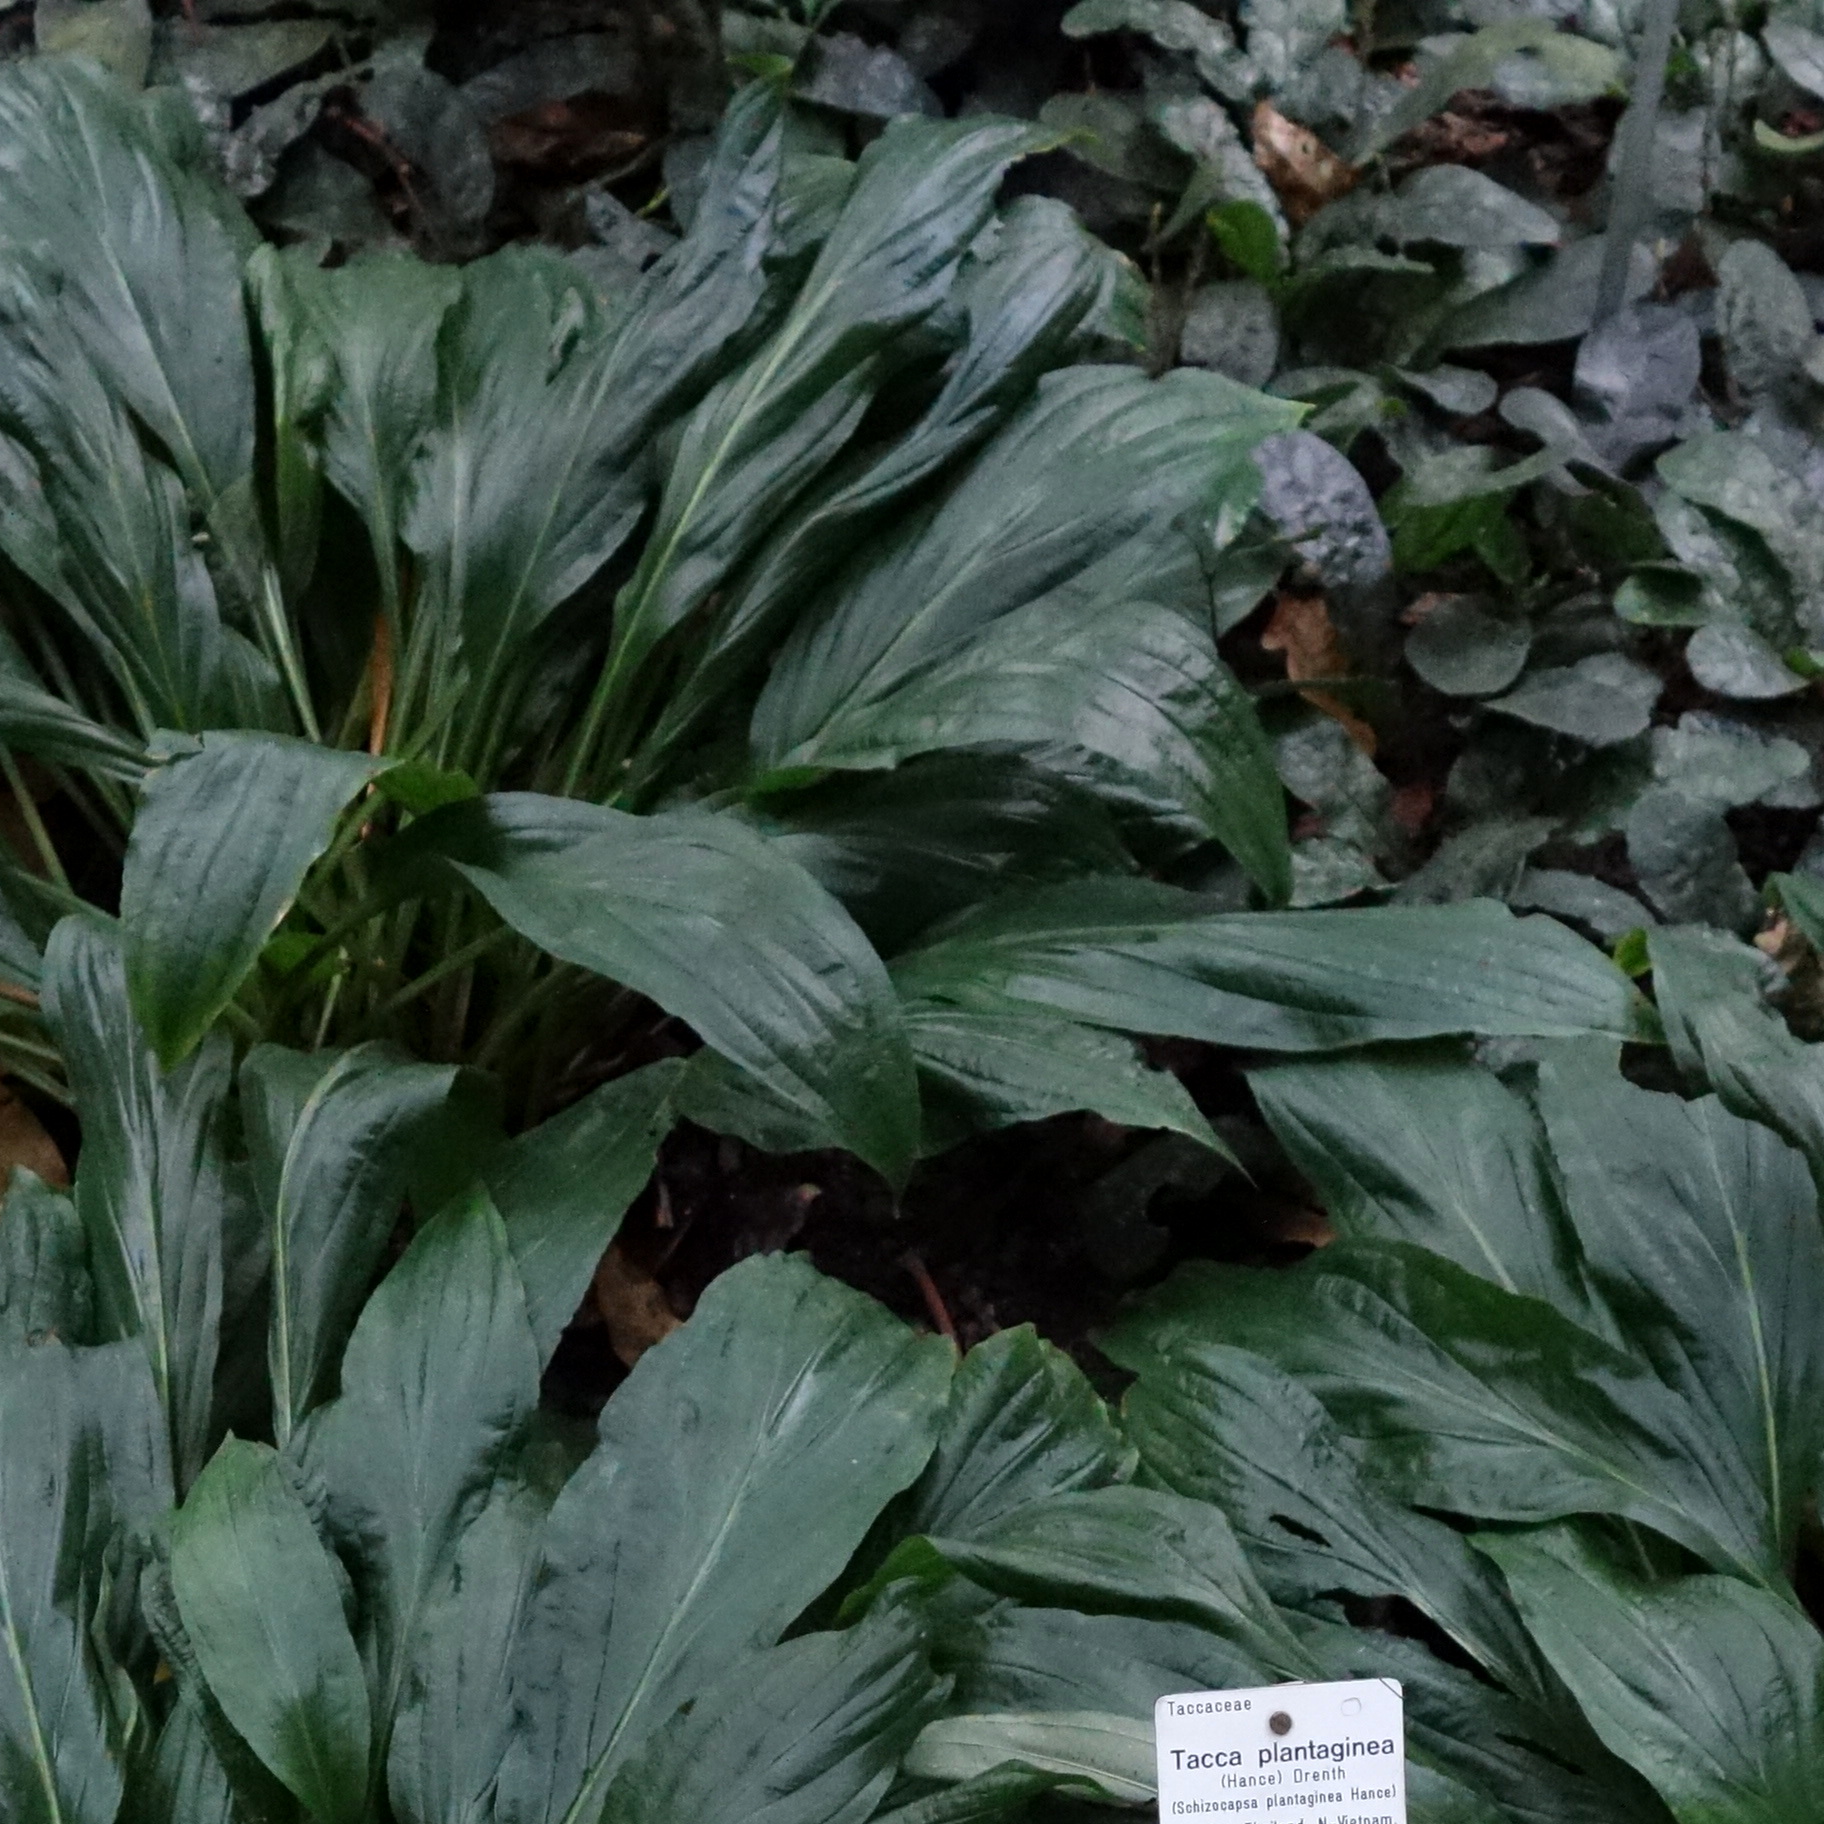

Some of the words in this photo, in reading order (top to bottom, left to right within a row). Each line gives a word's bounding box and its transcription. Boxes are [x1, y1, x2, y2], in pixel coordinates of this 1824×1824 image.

[1168, 1698, 1252, 1716] Taccaceae
[1170, 1748, 1242, 1770] Tacca
[1258, 1737, 1395, 1768] plantaginea
[1221, 1771, 1283, 1789] (Hance)
[1294, 1766, 1346, 1784] Drenth
[1172, 1797, 1258, 1815] (Schizocapsa
[1266, 1790, 1343, 1811] plantaginea
[1351, 1784, 1396, 1802] Hance)
